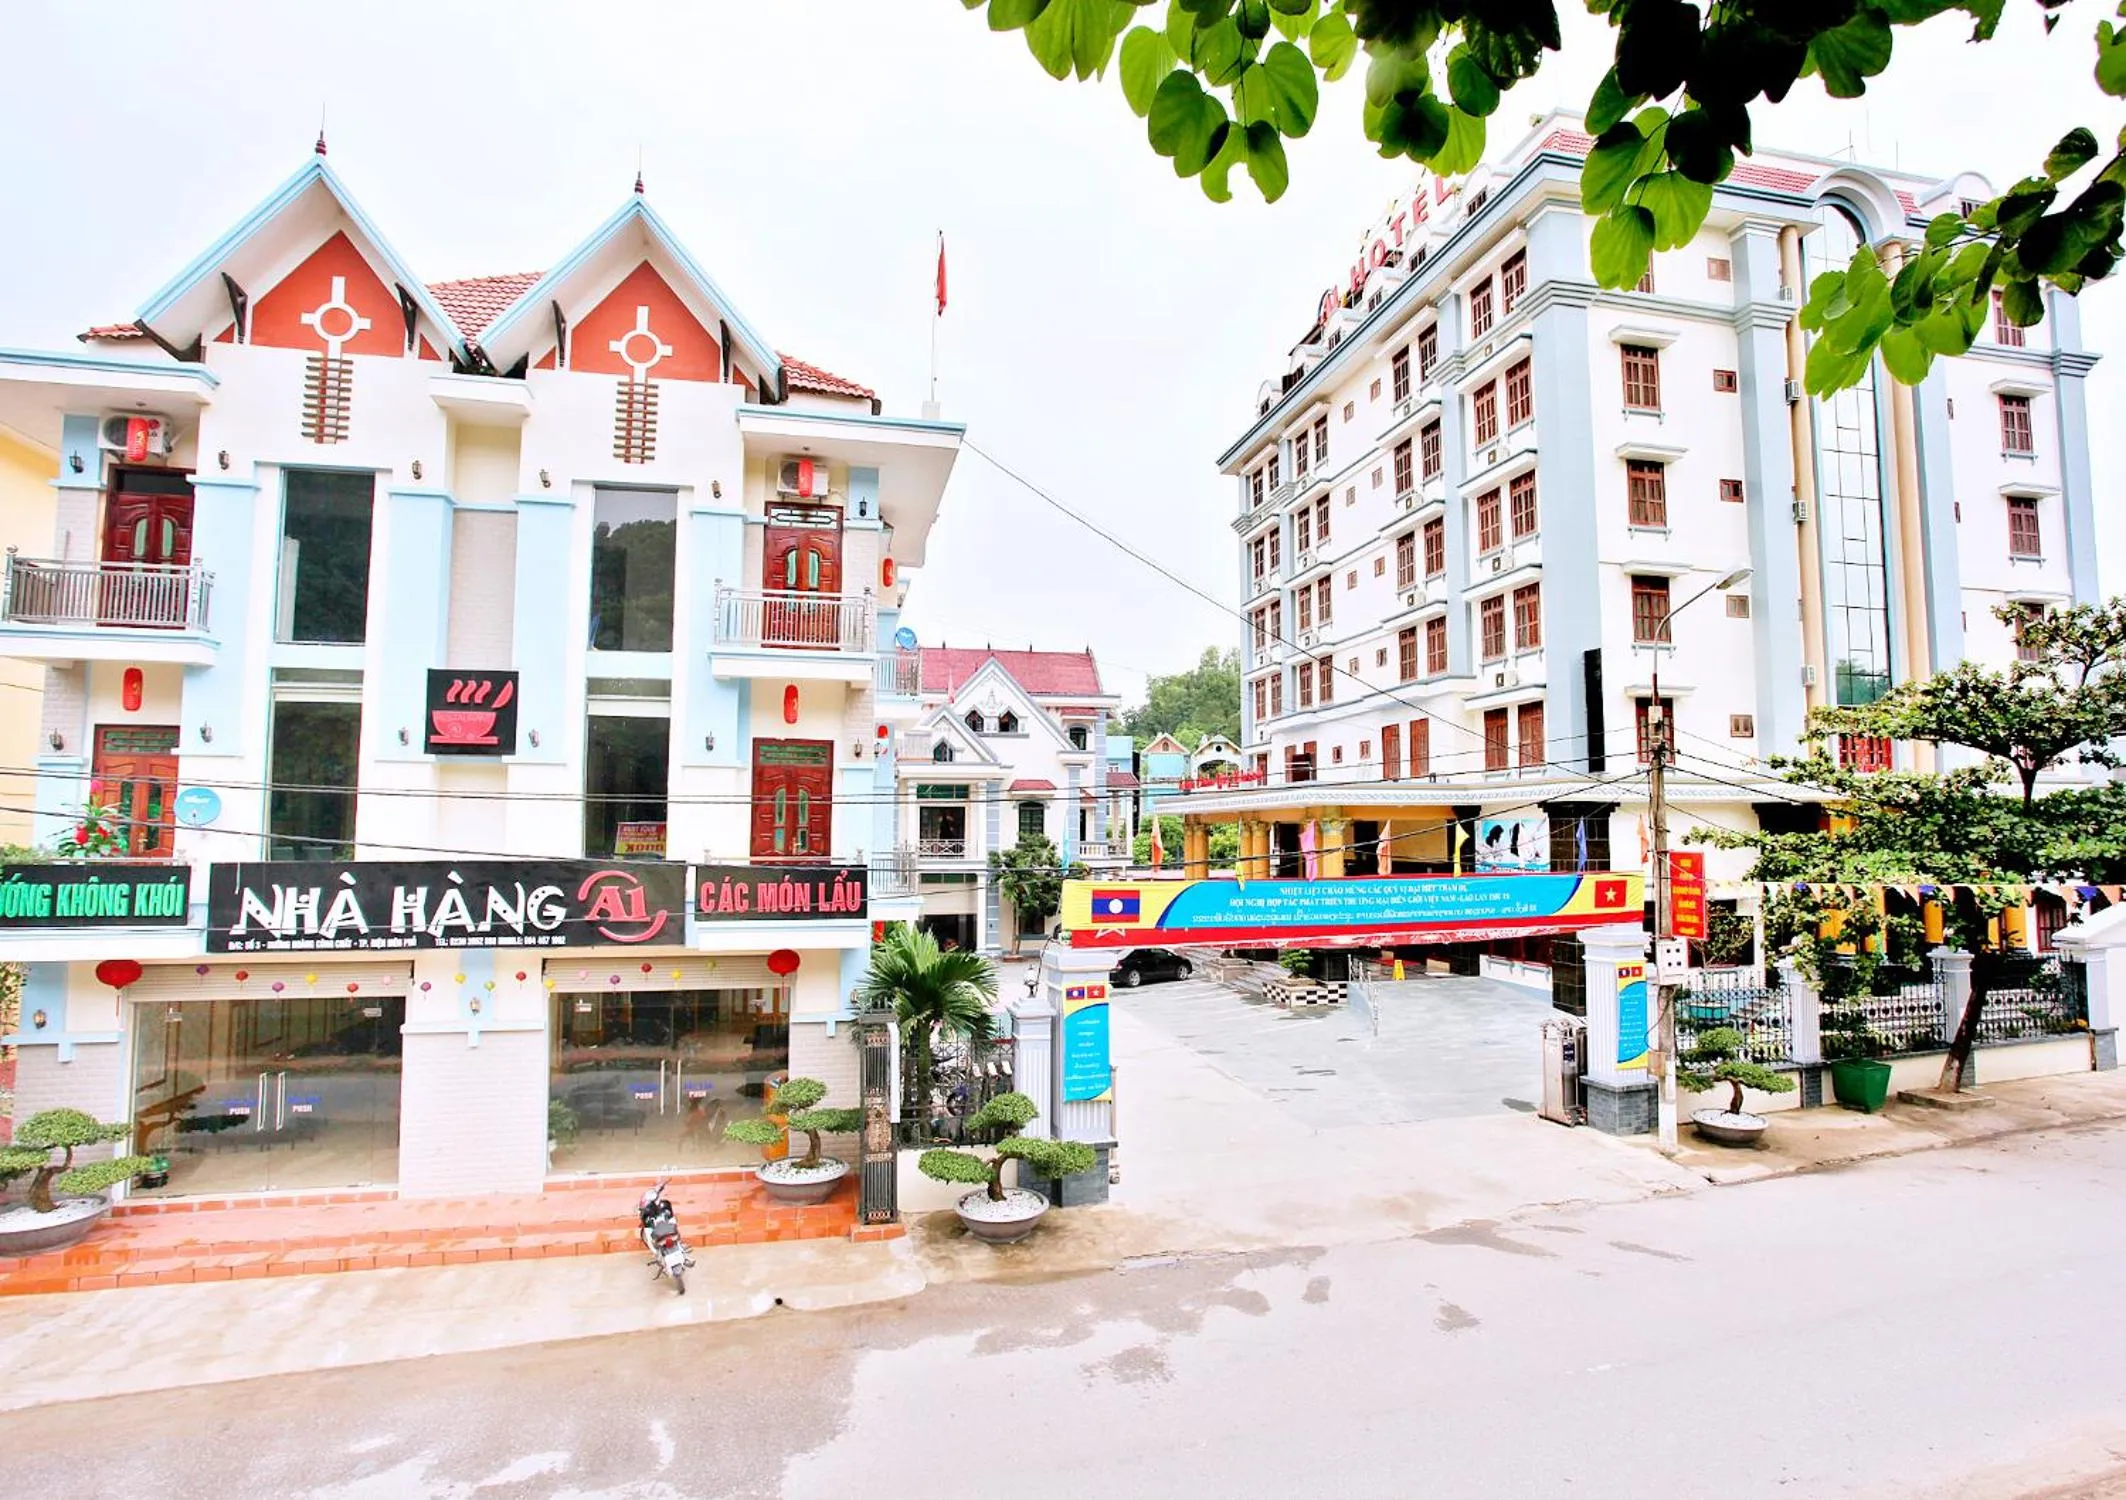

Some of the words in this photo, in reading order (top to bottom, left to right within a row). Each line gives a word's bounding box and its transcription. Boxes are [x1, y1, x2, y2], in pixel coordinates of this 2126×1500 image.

[1350, 176, 1456, 295] HOTEL
[56, 875, 130, 917] KHÔNG
[134, 875, 185, 917] KHÓI
[229, 871, 370, 939] NHÀ
[390, 871, 567, 938] HÀNG
[584, 885, 651, 922] A1
[700, 875, 749, 914] CÁC
[757, 874, 811, 913] MÓN
[818, 869, 862, 912] LẨU
